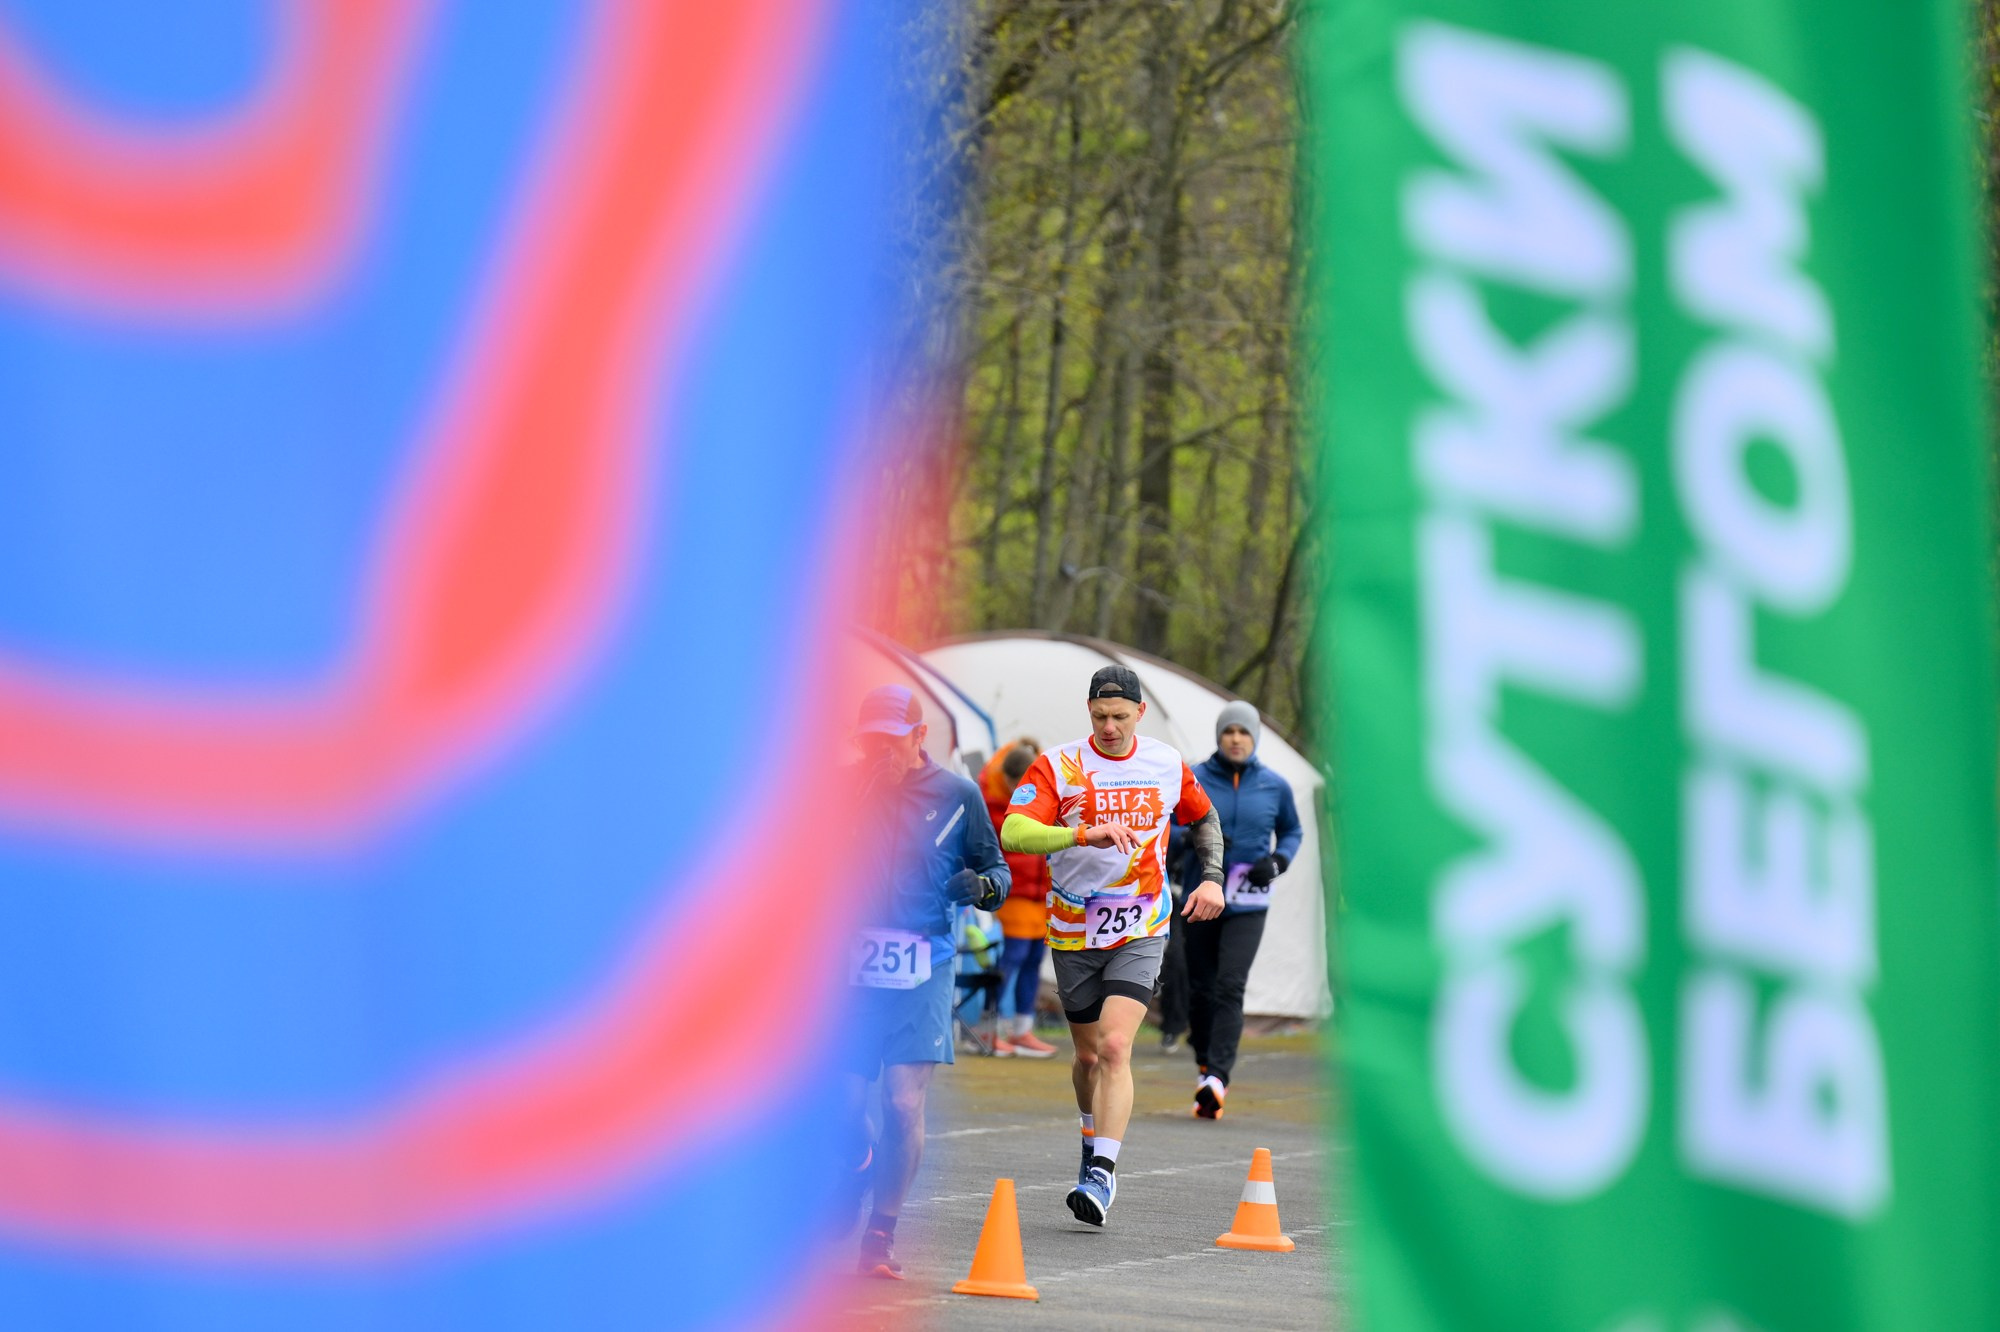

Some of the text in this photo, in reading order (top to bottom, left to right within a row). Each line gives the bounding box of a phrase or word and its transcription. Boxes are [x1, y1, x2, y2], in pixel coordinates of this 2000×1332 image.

[1396, 20, 1652, 1203] СУТКИ
[1659, 43, 1892, 1221] БЕГОМ
[1095, 790, 1130, 811] БЕГ
[1095, 811, 1154, 827] СЧАСТЬЯ
[1096, 904, 1143, 935] 253
[861, 939, 917, 975] 251
